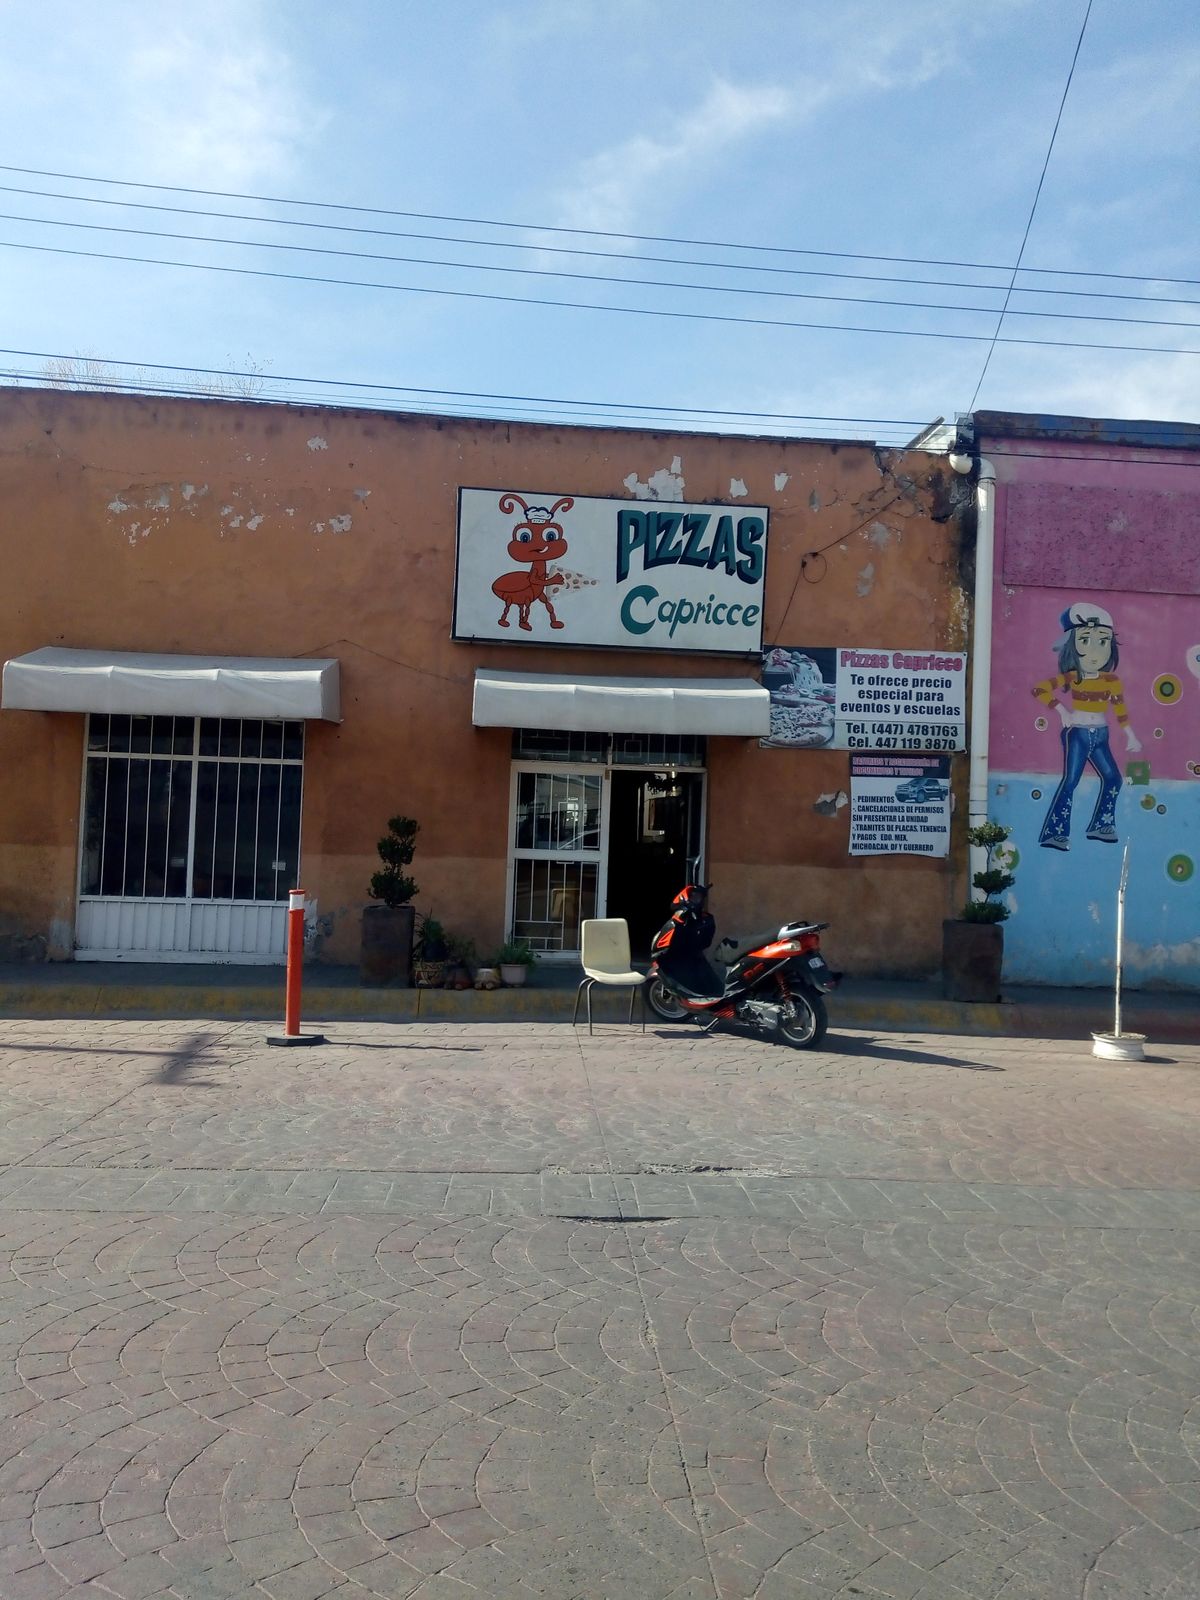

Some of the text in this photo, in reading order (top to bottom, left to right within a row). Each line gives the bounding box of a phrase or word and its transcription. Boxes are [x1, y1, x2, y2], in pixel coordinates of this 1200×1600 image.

[616, 509, 764, 584] PIZZAS
[620, 584, 760, 639] Capricce
[840, 650, 890, 668] Pizzas
[850, 674, 952, 689] Te ofrece precio
[858, 689, 944, 702] especial para
[840, 702, 961, 716] eventos y escuelas
[845, 722, 959, 737] Tel. (447) 4781763
[848, 736, 956, 750] Cel. 447 119 3870
[857, 795, 895, 804] PEDIMENTOS
[857, 805, 905, 813] CANCELACIONES
[906, 805, 913, 813] DE
[914, 806, 944, 814] PERMISOS
[852, 814, 929, 823] SIN PRESENTAR LA UNIDAD
[886, 824, 894, 832] DE
[903, 844, 934, 852] GUERRERO
